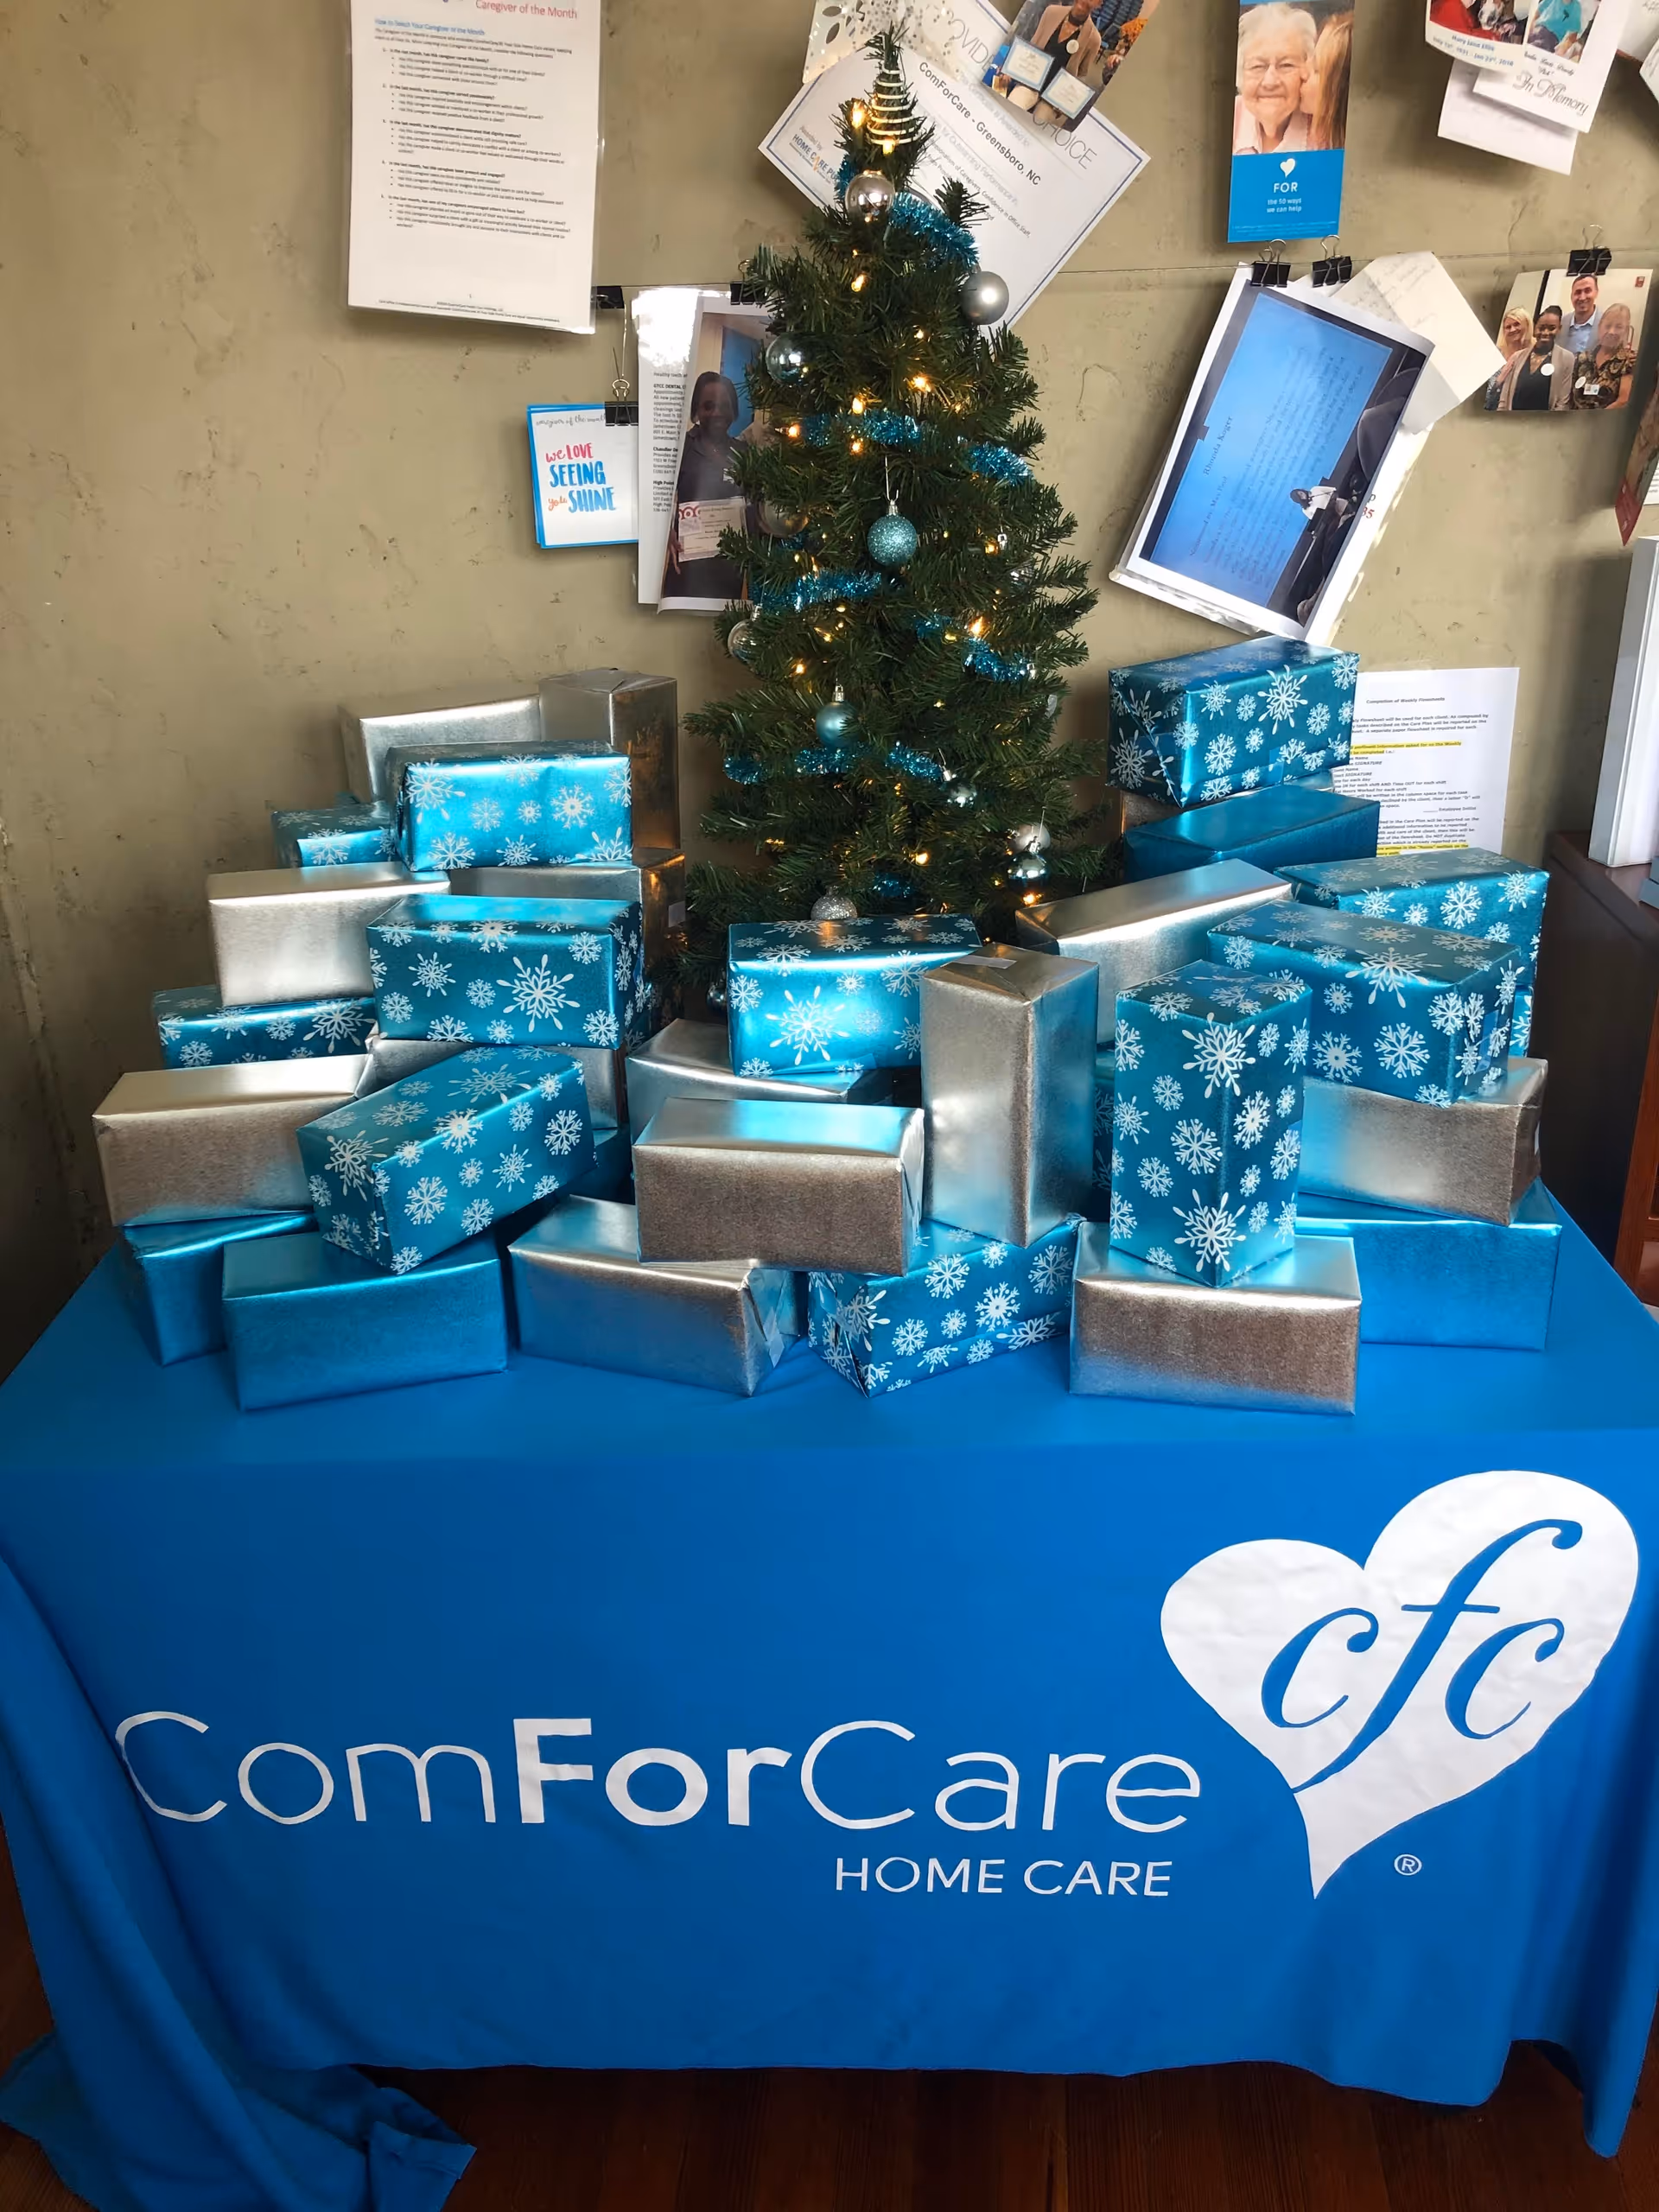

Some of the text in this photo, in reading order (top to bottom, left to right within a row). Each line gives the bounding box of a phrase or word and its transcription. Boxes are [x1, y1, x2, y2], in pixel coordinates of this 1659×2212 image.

[475, 0, 577, 20] Caregiver of the Month
[1512, 69, 1591, 117] In Memory
[918, 61, 972, 118] ComForCare
[976, 121, 1026, 175] Greensboro,
[1026, 169, 1042, 187] NC
[791, 133, 812, 155] HOME
[1273, 181, 1299, 193] FOR
[1288, 205, 1302, 213] help
[545, 442, 594, 463] we LOVE
[1202, 443, 1221, 477] Rhonda
[1217, 415, 1233, 442] Koger
[549, 460, 607, 488] SEEING
[547, 486, 617, 513] you SHINE
[114, 1710, 1201, 1834] ComForCare
[836, 1856, 1173, 1897] HOME CARE
